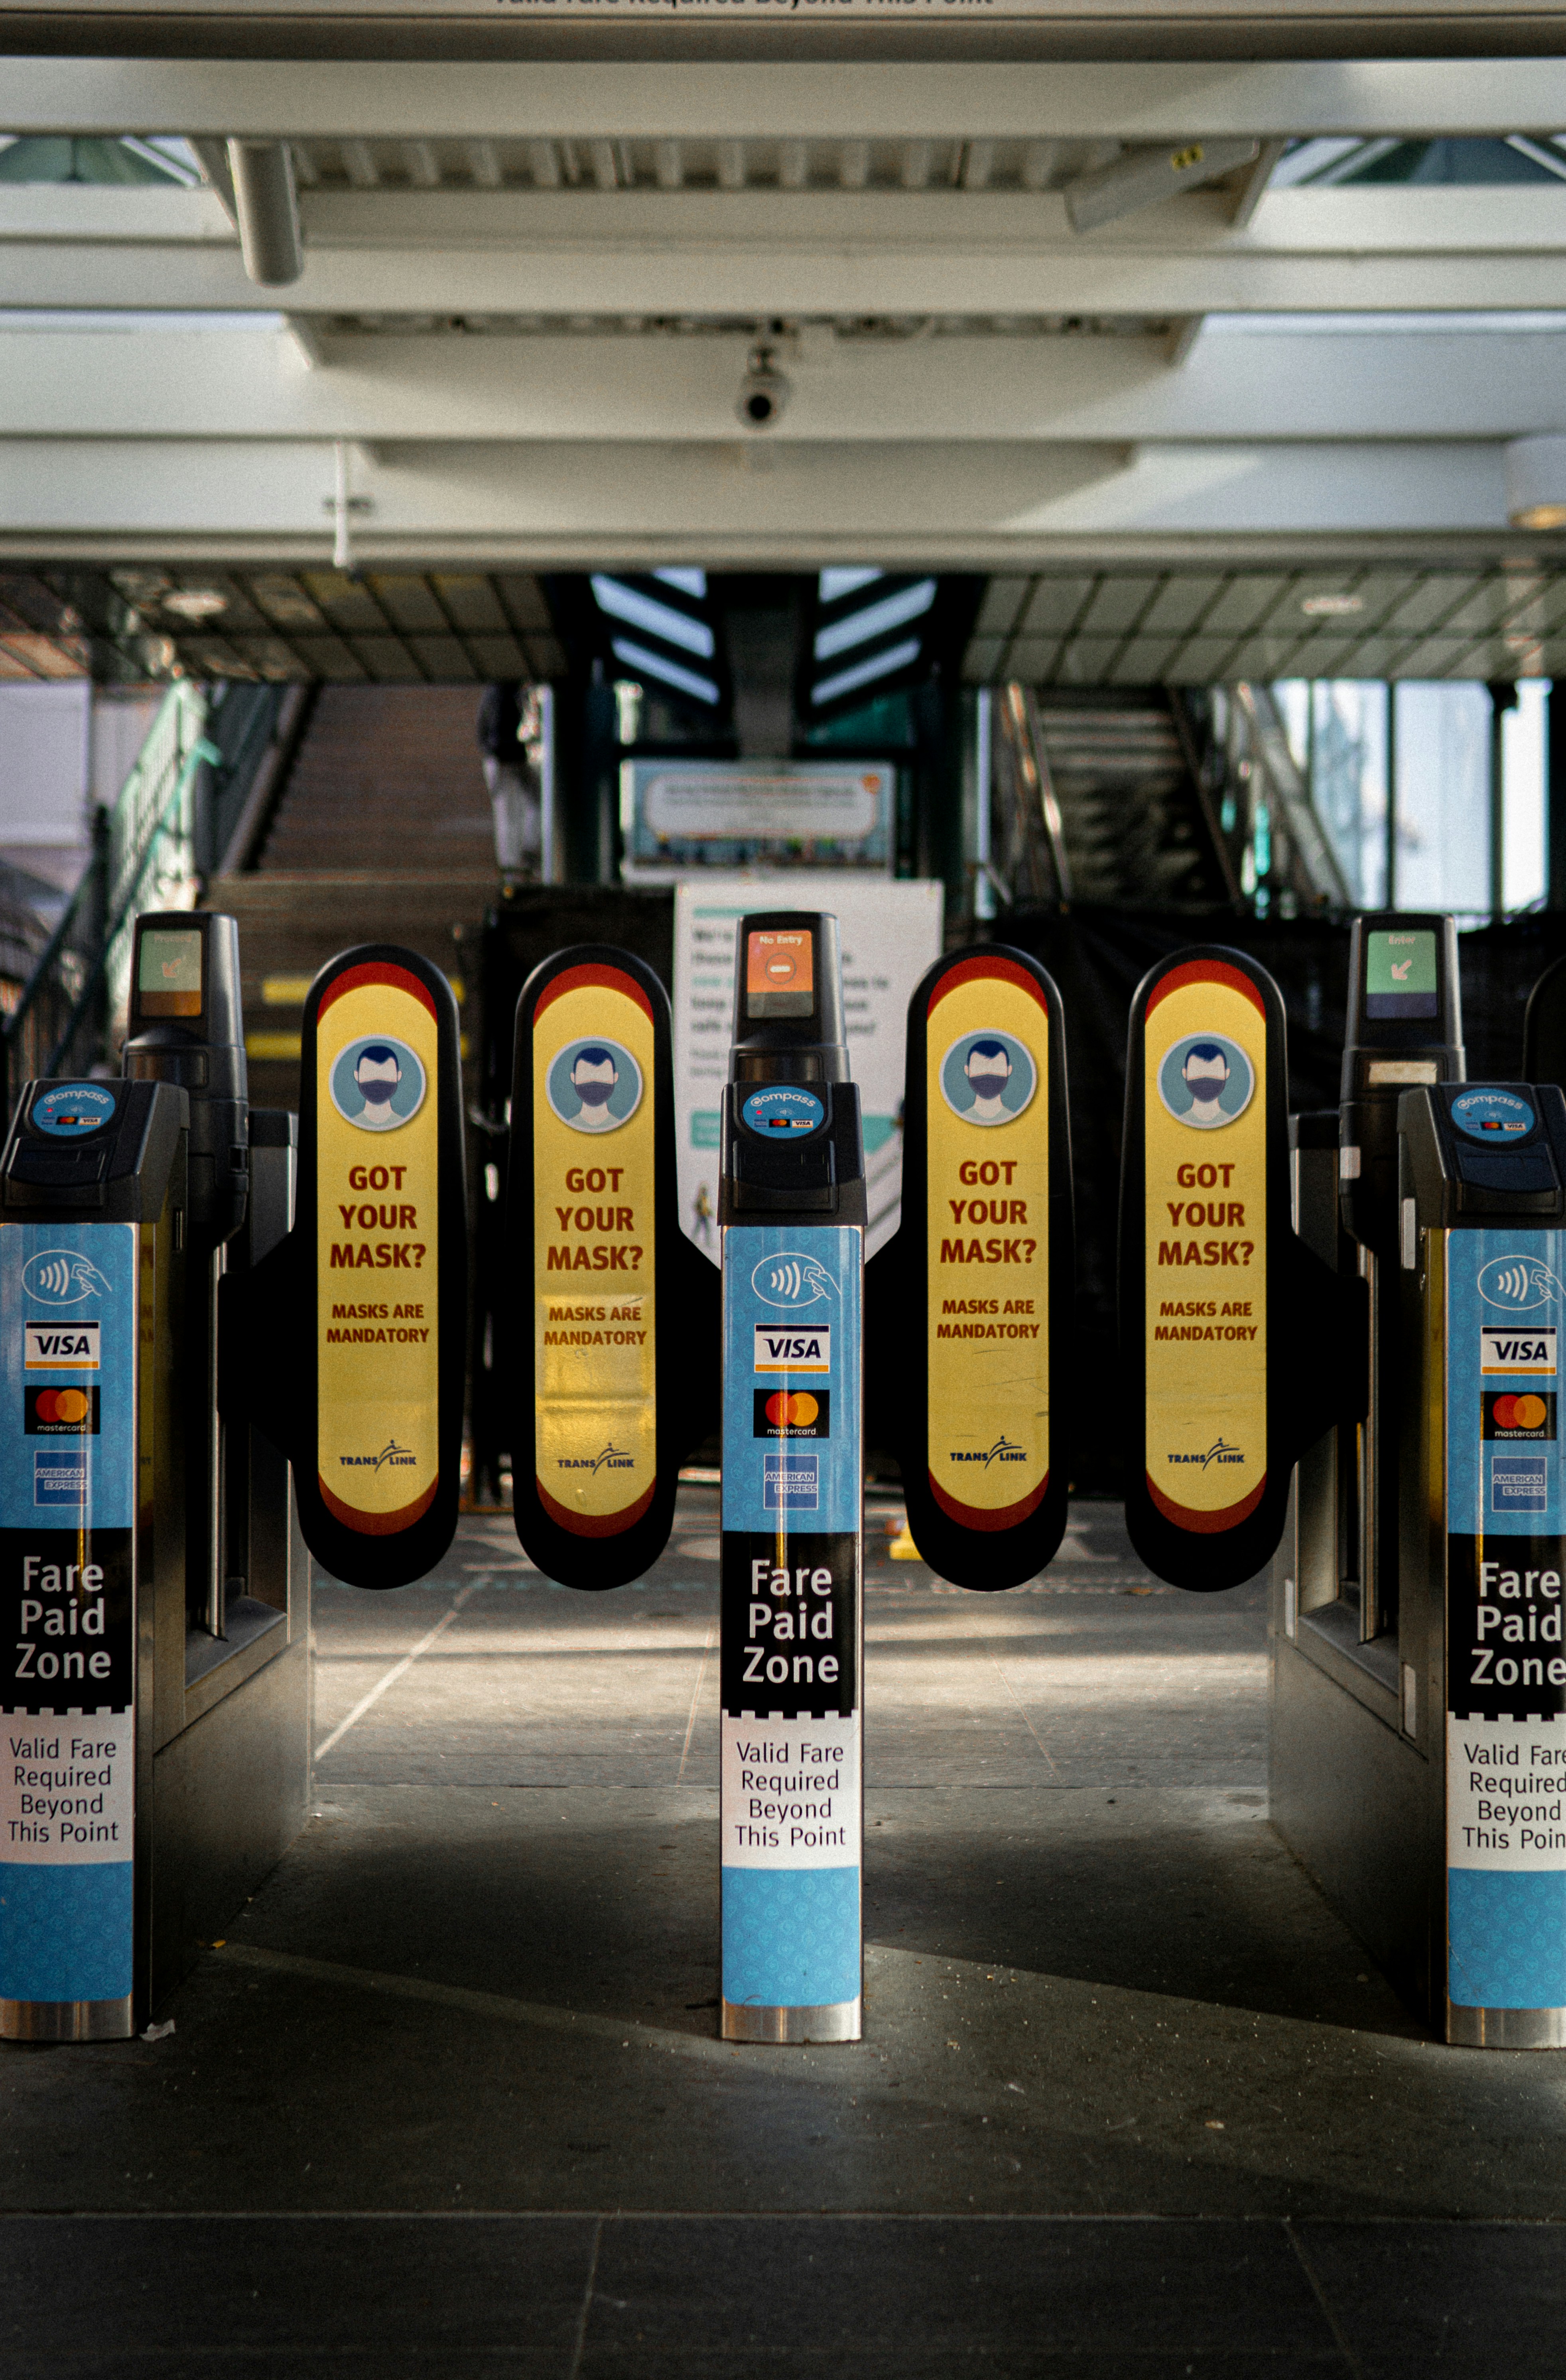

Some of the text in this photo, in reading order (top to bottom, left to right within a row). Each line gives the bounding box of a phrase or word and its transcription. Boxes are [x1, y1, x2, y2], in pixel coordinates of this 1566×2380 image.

[759, 935, 802, 946] No Entry
[1389, 936, 1415, 944] Enter
[44, 1090, 109, 1104] Compass
[750, 1093, 816, 1107] Compass
[1457, 1096, 1523, 1109] Compass
[349, 1166, 407, 1190] GOT
[566, 1168, 624, 1192] GOT
[959, 1161, 1017, 1186] GOT
[1177, 1164, 1235, 1188] GOT
[339, 1204, 417, 1229] YOUR
[555, 1207, 634, 1231] YOUR
[949, 1200, 1027, 1224] YOUR
[1167, 1202, 1245, 1227] YOUR
[330, 1243, 426, 1268] MASK?
[548, 1245, 643, 1271] MASK?
[940, 1239, 1036, 1263] MASK?
[1158, 1241, 1254, 1266] MASK?
[332, 1304, 424, 1319] MASKS ARE
[549, 1307, 642, 1321] MASKS ARE
[942, 1300, 1034, 1314] MASKS ARE
[1160, 1302, 1252, 1316] MASKS ARE
[327, 1328, 429, 1343] MANDATORY
[544, 1331, 647, 1345] MANDATORY
[937, 1324, 1040, 1338] MANDATORY
[1155, 1326, 1257, 1340] MANDATORY
[34, 1336, 89, 1355] VISA
[764, 1339, 820, 1358] VISA
[1491, 1341, 1547, 1360] VISA
[35, 1469, 84, 1477] AMERICAN
[765, 1473, 814, 1481] AMERICAN
[1493, 1475, 1542, 1483] AMERICAN
[44, 1481, 87, 1489] EXPRESS
[775, 1485, 817, 1493] EXPRESS
[1503, 1487, 1546, 1495] EXPRESS
[23, 1556, 104, 1592] Fare
[752, 1560, 831, 1595] Fare
[1481, 1562, 1561, 1598] Fare
[22, 1597, 104, 1635] Paid
[750, 1601, 832, 1640] Paid
[1477, 1604, 1562, 1642] Paid
[15, 1643, 111, 1679] Zone
[743, 1647, 839, 1683] Zone
[1471, 1649, 1566, 1685] Zone
[10, 1737, 116, 1759] Valid Fare
[737, 1742, 843, 1763] Valid Fare
[1464, 1743, 1519, 1765] Valid
[14, 1765, 110, 1792] Required
[742, 1769, 838, 1796] Required
[1470, 1772, 1566, 1798] Required
[21, 1793, 102, 1819] Beyond
[750, 1798, 831, 1824] Beyond
[1478, 1800, 1560, 1826] Beyond
[8, 1821, 118, 1843] This Point
[735, 1825, 845, 1847] This Point
[1462, 1827, 1509, 1849] This
